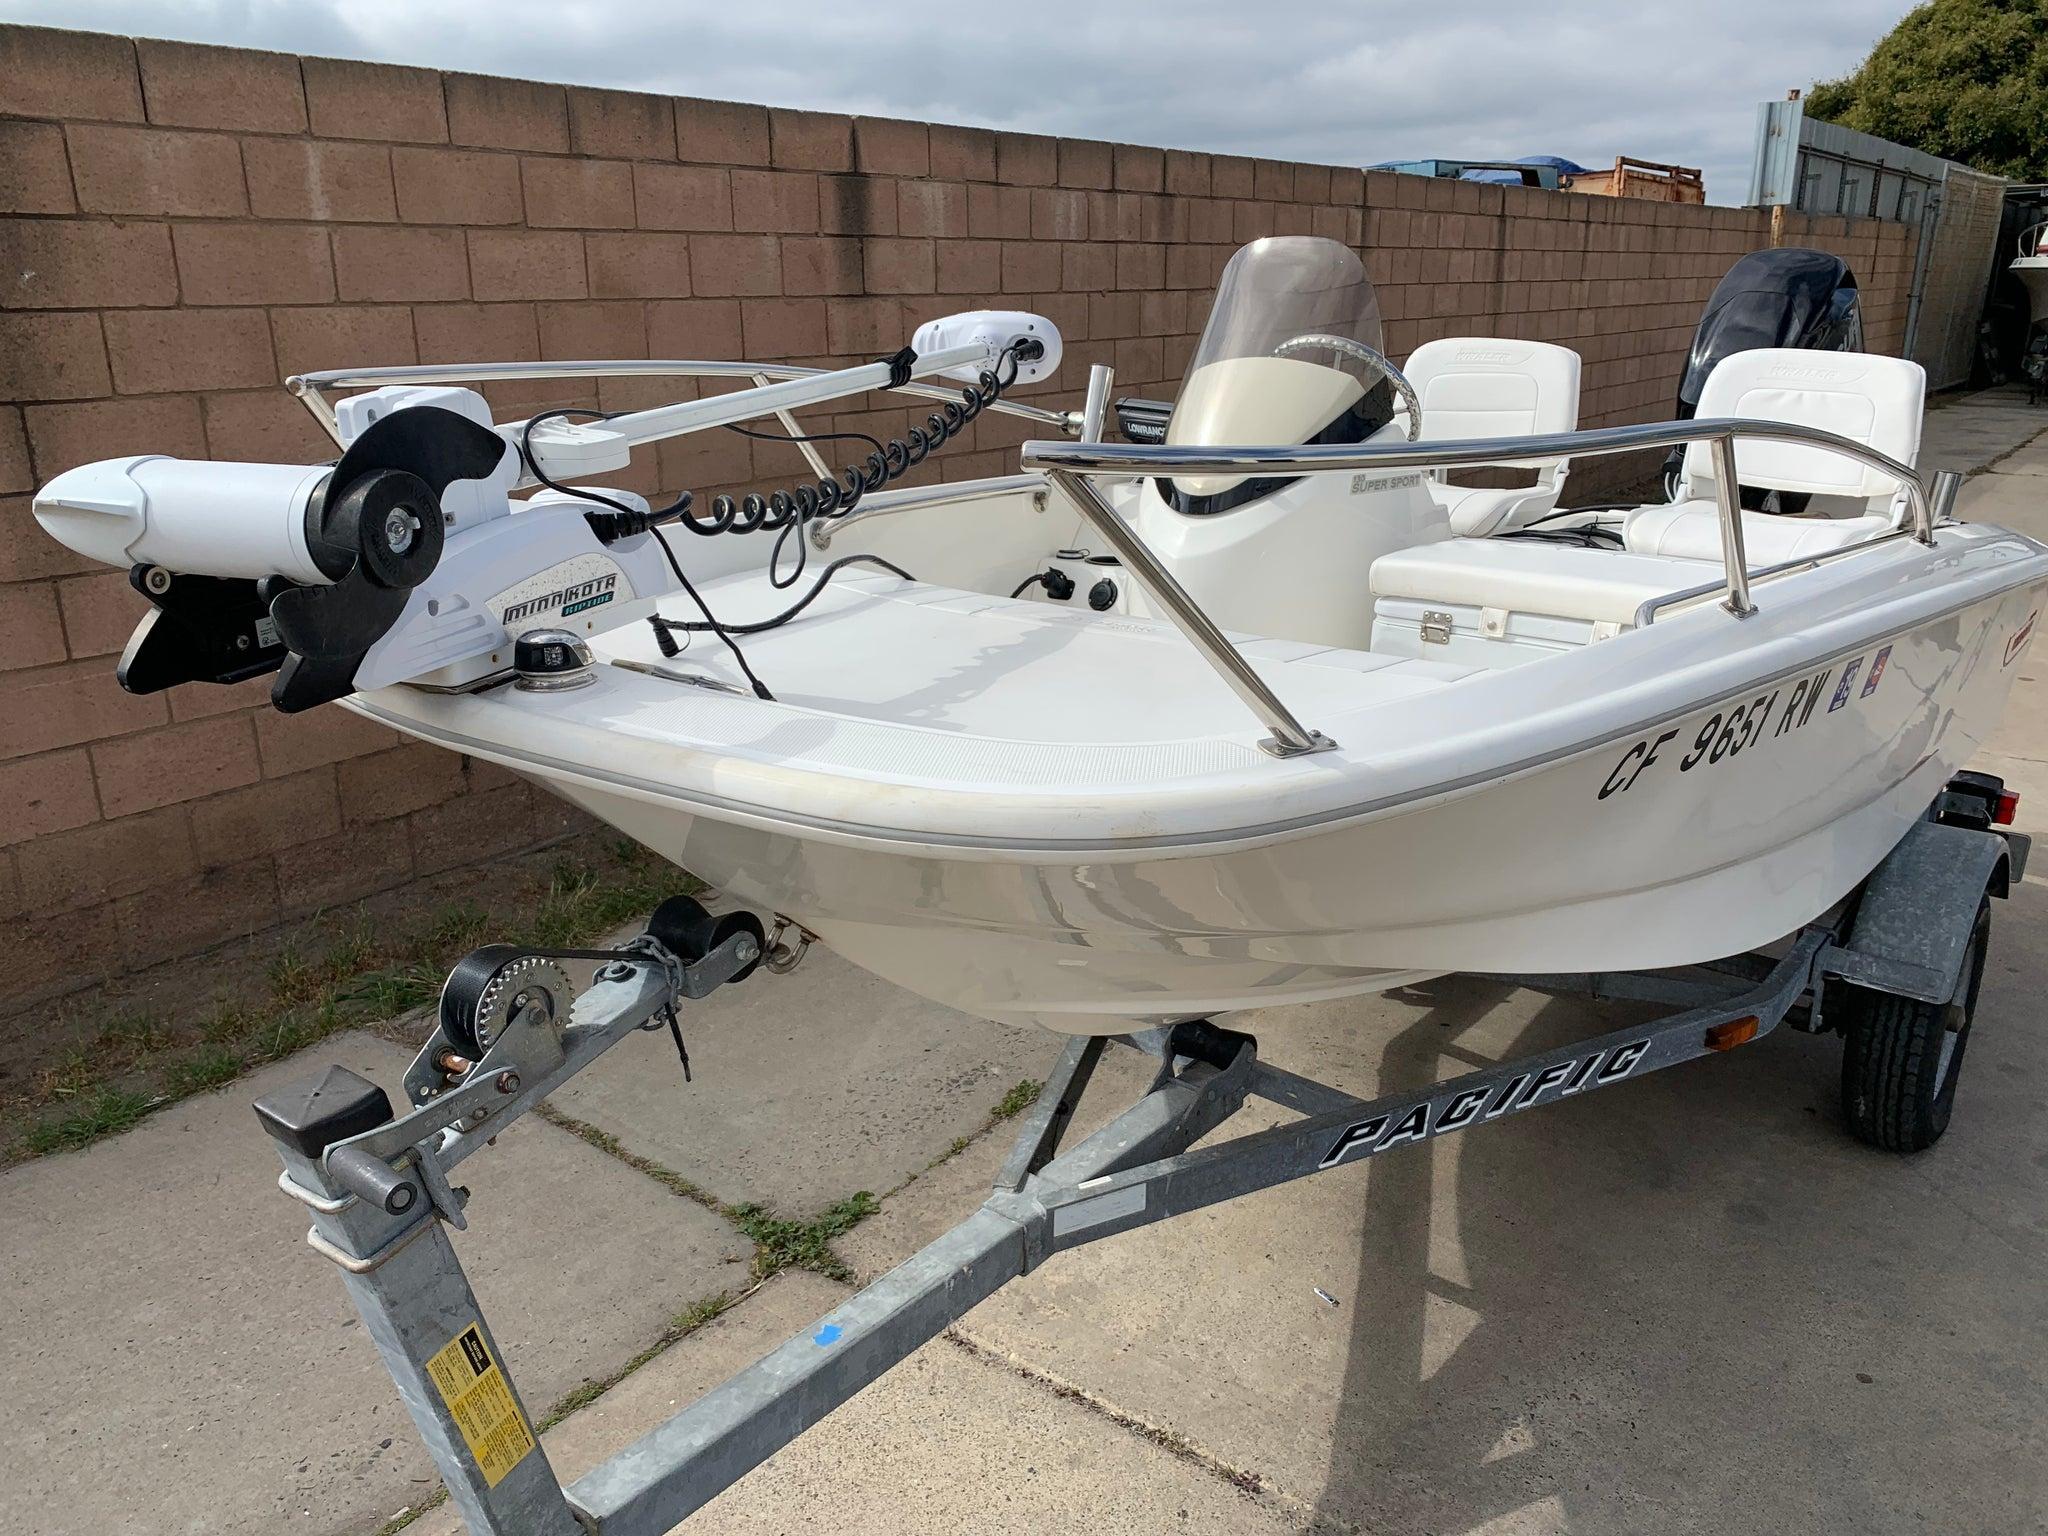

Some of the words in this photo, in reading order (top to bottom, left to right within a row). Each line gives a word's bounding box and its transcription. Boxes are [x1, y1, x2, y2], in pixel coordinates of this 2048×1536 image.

[1351, 480, 1388, 494] SUPER
[1390, 473, 1421, 488] SPORT
[502, 591, 563, 625] MINN
[563, 573, 617, 604] KOTA
[563, 591, 614, 617] RIPTIDE
[1597, 727, 1680, 801] CF
[1680, 690, 1779, 773] 9651
[1774, 669, 1832, 738] RW
[1317, 1038, 1652, 1169] PACIFIC
